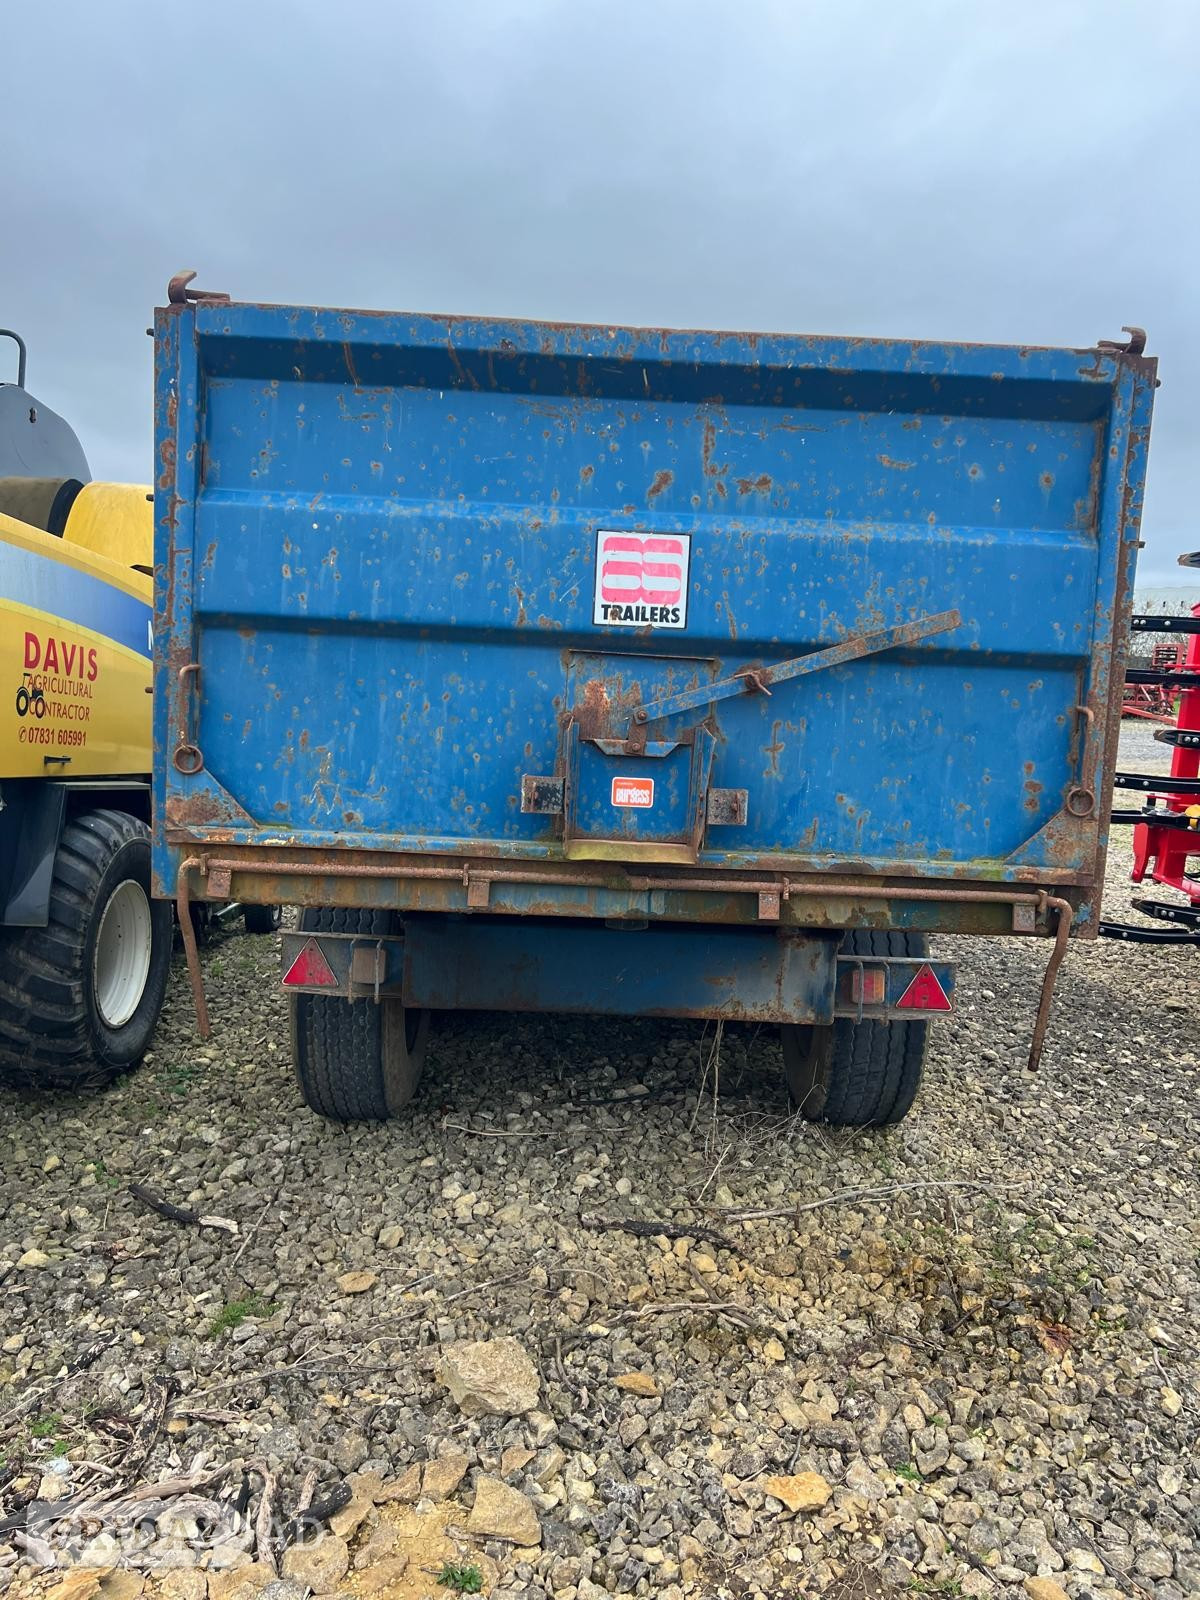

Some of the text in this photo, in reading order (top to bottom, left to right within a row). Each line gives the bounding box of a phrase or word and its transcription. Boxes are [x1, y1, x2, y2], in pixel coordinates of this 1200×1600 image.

[601, 604, 680, 623] TRAILERS
[23, 631, 98, 682] DAVIS
[27, 674, 93, 699] AGRICULTURAL
[28, 697, 90, 721] CONTRACTOR
[28, 727, 87, 746] 07831 605991
